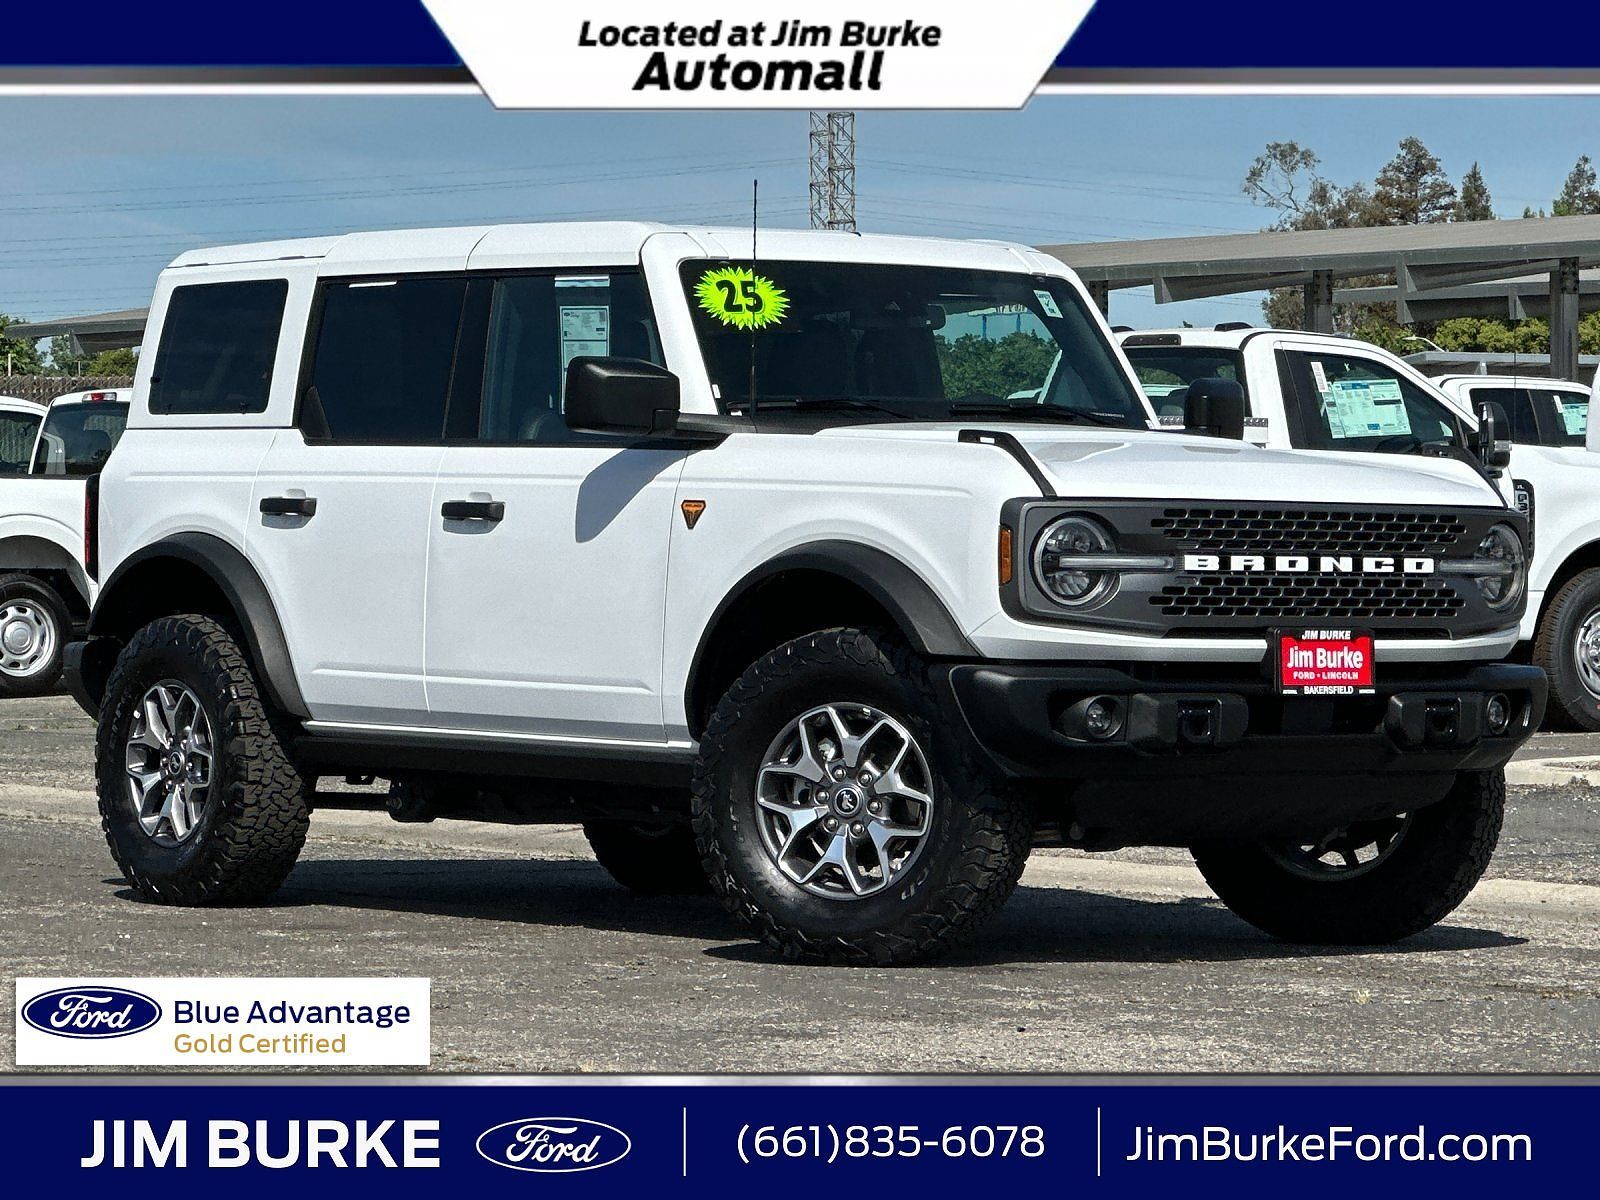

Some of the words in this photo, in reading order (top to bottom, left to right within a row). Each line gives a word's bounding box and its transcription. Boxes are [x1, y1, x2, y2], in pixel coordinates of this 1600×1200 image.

[715, 279, 763, 312] 25
[1184, 554, 1434, 574] BRONCO
[1302, 630, 1318, 640] JIM
[1320, 630, 1351, 640] BURKE
[1287, 646, 1313, 668] Jim
[1316, 646, 1364, 669] Burke
[1293, 672, 1315, 680] FORD
[1322, 672, 1359, 680] LINCOLN
[1303, 686, 1354, 695] BAKERSFIELD
